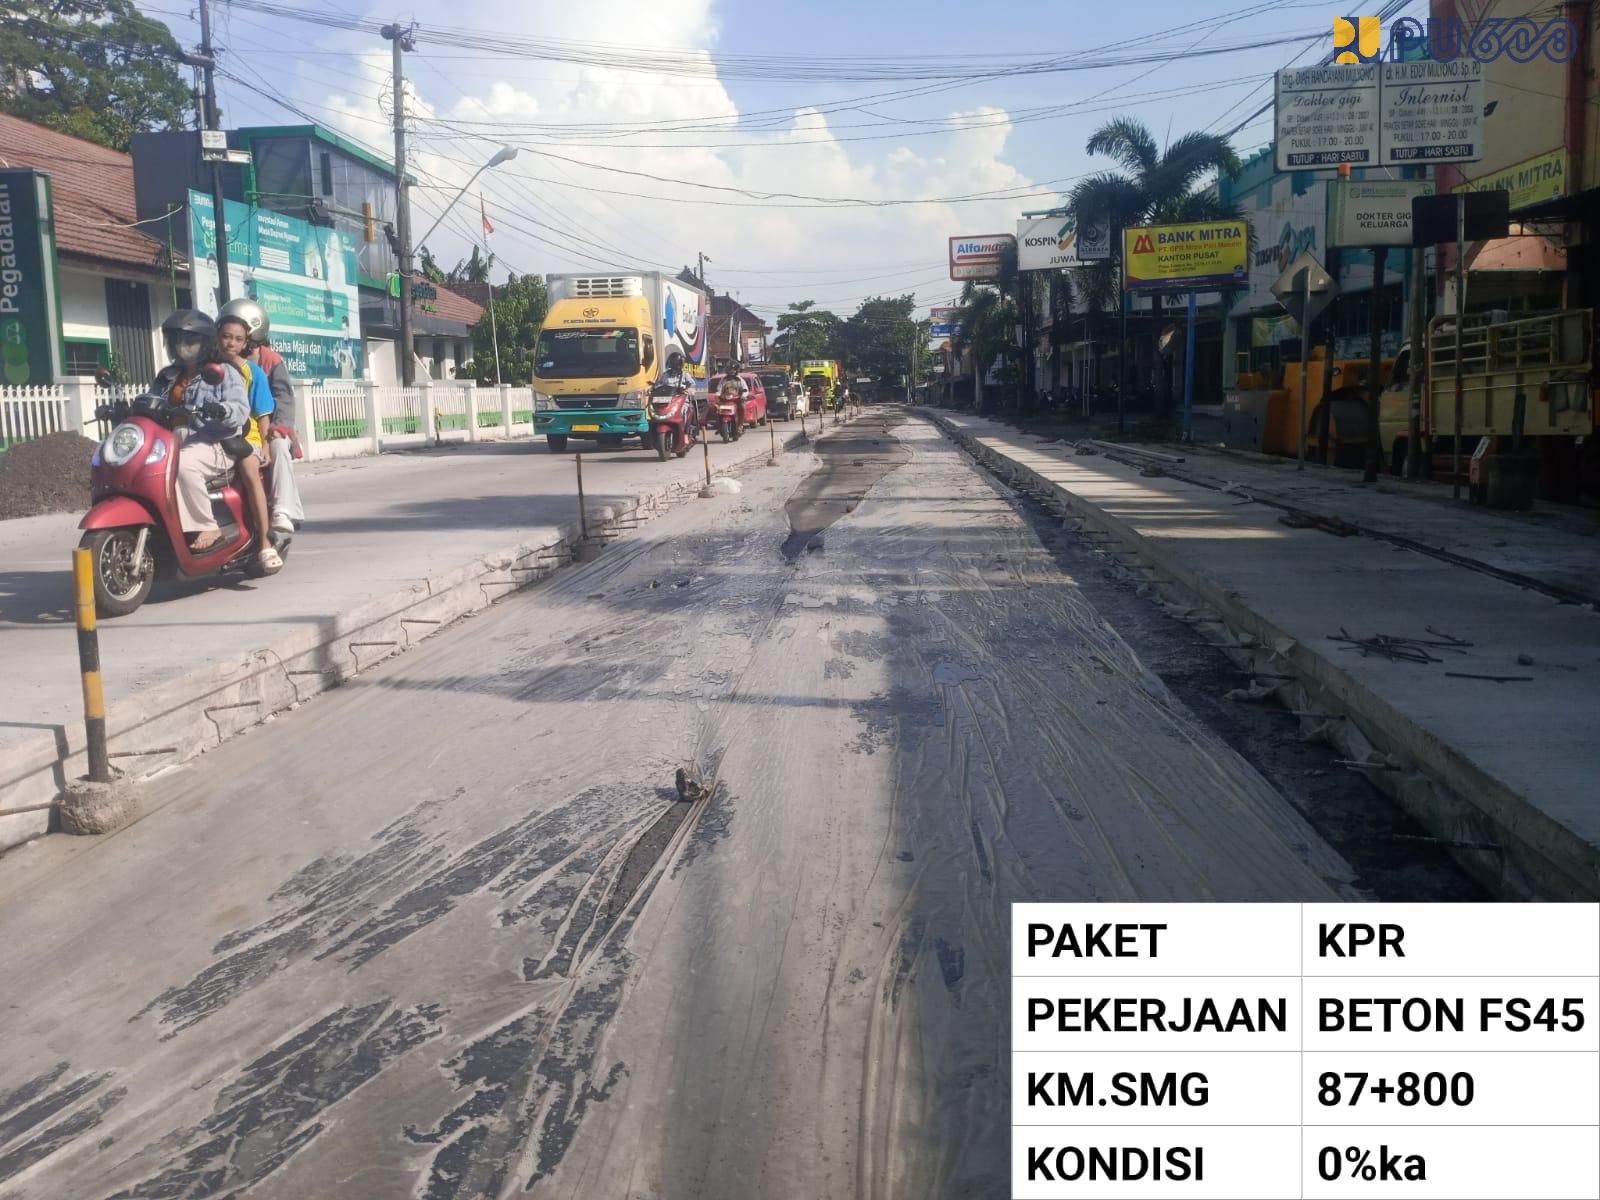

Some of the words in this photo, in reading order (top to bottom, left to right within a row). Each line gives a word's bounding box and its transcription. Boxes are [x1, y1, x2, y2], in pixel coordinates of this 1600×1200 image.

[1393, 84, 1469, 106] Internist
[1292, 154, 1314, 164] TUTUP
[1321, 152, 1340, 162] HARI
[1341, 151, 1365, 161] SABTU
[1395, 148, 1418, 158] TUTUP
[1424, 147, 1443, 157] HARI
[1444, 146, 1469, 156] SABTU
[1518, 158, 1562, 188] MITRA
[1356, 212, 1394, 221] DOKTER
[1396, 212, 1412, 220] GIG
[1360, 220, 1408, 228] KELUARGA
[1158, 230, 1195, 244] BANK
[1200, 227, 1242, 240] MITRA
[957, 242, 1001, 254] Alfama
[1025, 236, 1057, 248] KOSPIN
[1050, 255, 1078, 264] JUWA
[1158, 253, 1191, 262] KANTOR
[1194, 250, 1220, 260] PUSAT
[269, 338, 292, 353] Usaha
[292, 340, 308, 357] Maju
[310, 340, 322, 355] dan
[288, 358, 306, 372] Kelas
